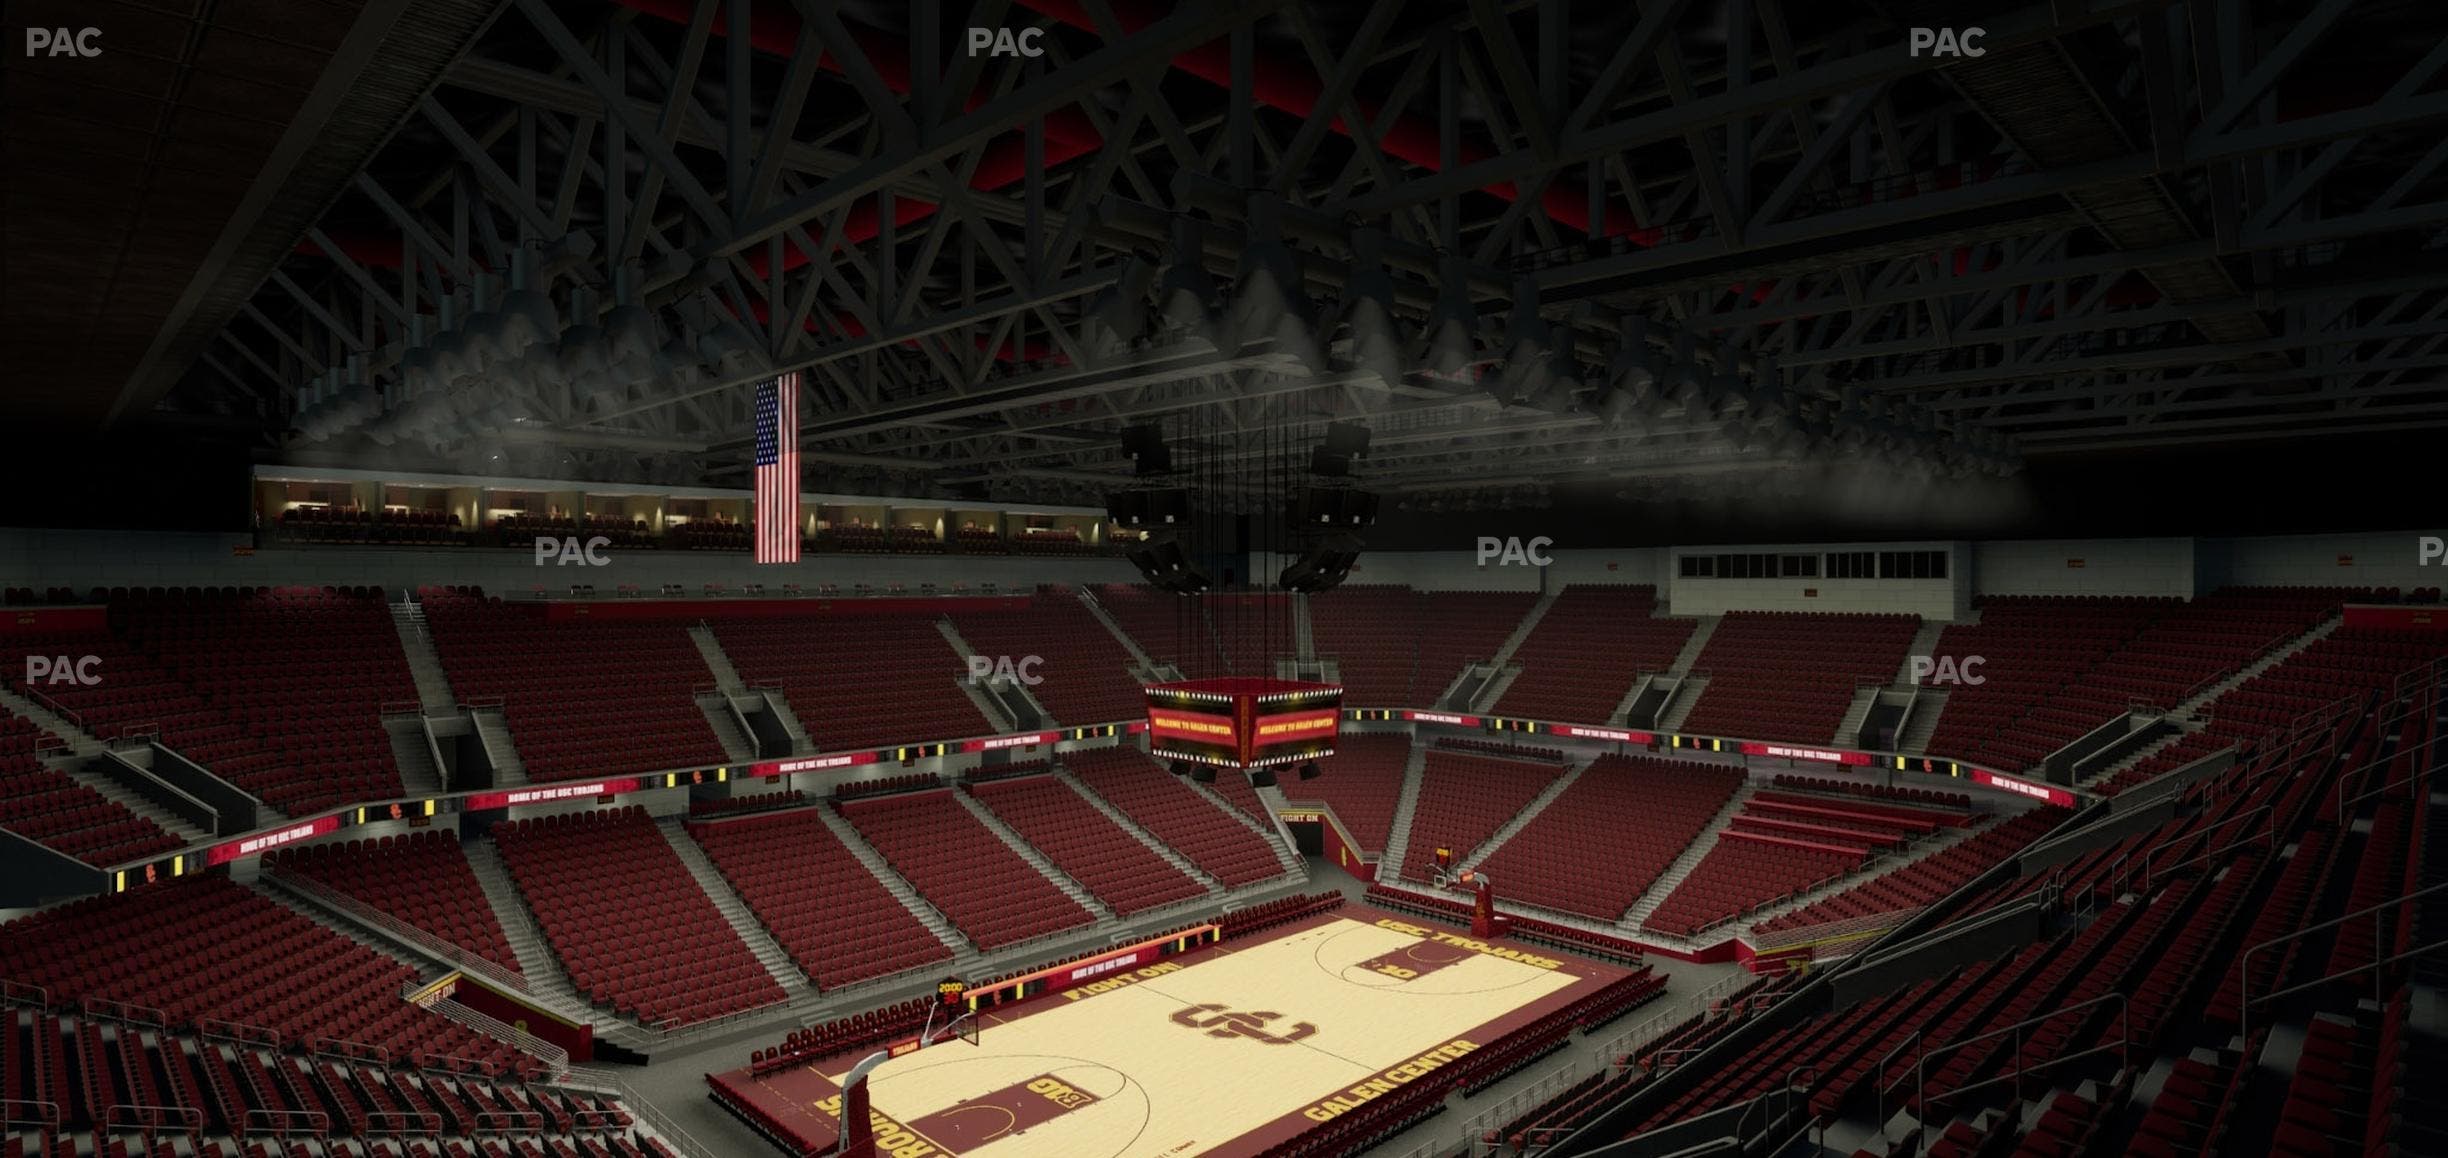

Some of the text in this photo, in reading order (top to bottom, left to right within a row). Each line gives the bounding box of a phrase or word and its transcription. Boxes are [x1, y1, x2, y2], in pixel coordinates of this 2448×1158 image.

[508, 784, 604, 803] HOME OF THE USC TROJANS
[1432, 932, 1565, 970] TROJANS
[938, 982, 963, 993] 20:00
[1061, 972, 1139, 1001] FIGHT
[1303, 1039, 1481, 1123] GALEN CENTER
